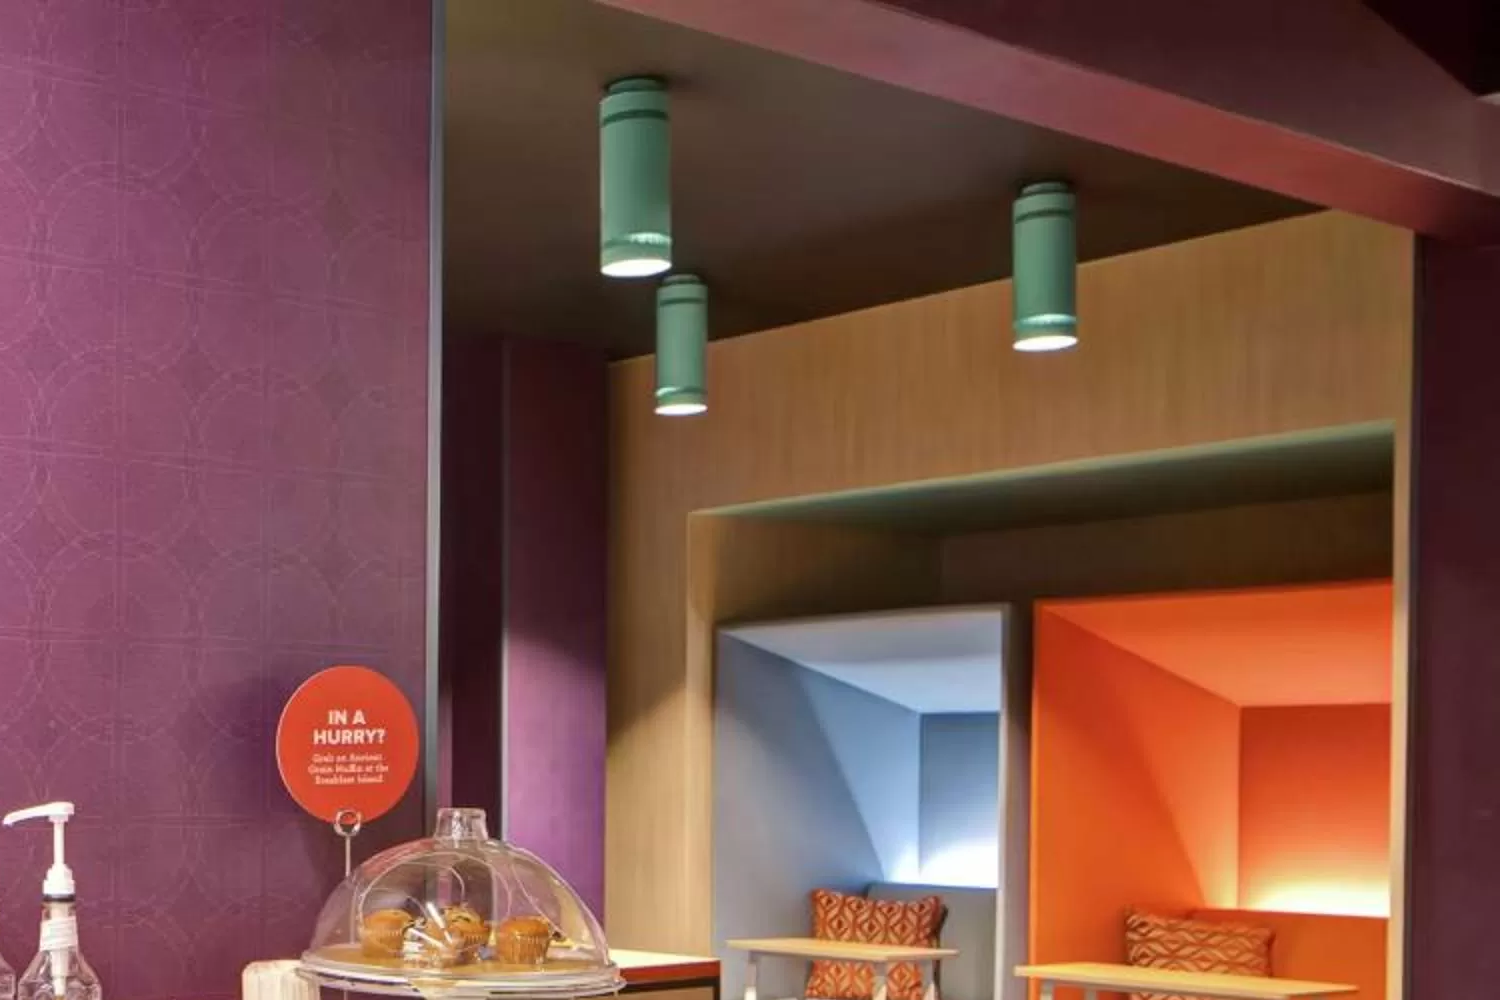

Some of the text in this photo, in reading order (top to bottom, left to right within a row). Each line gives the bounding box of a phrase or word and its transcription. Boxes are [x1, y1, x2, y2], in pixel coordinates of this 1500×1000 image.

[328, 709, 366, 725] IN A
[312, 728, 386, 744] HURRY?
